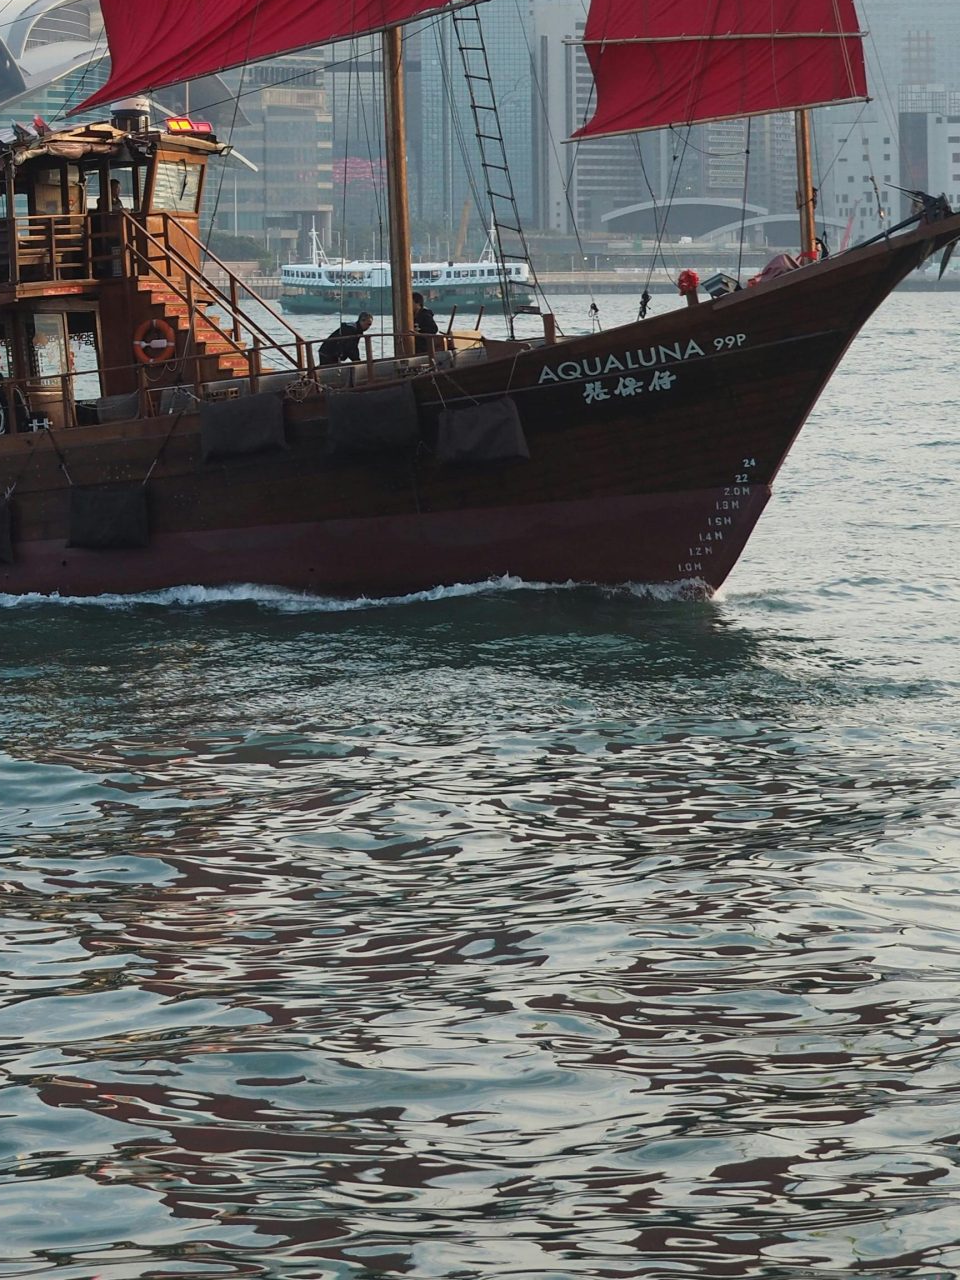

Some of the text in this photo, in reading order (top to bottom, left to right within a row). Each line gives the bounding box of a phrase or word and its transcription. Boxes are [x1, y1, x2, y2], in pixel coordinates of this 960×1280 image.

[538, 338, 705, 384] AQUALUNA
[582, 370, 677, 404] 張保仔
[742, 458, 756, 468] 24
[735, 473, 748, 483] 22
